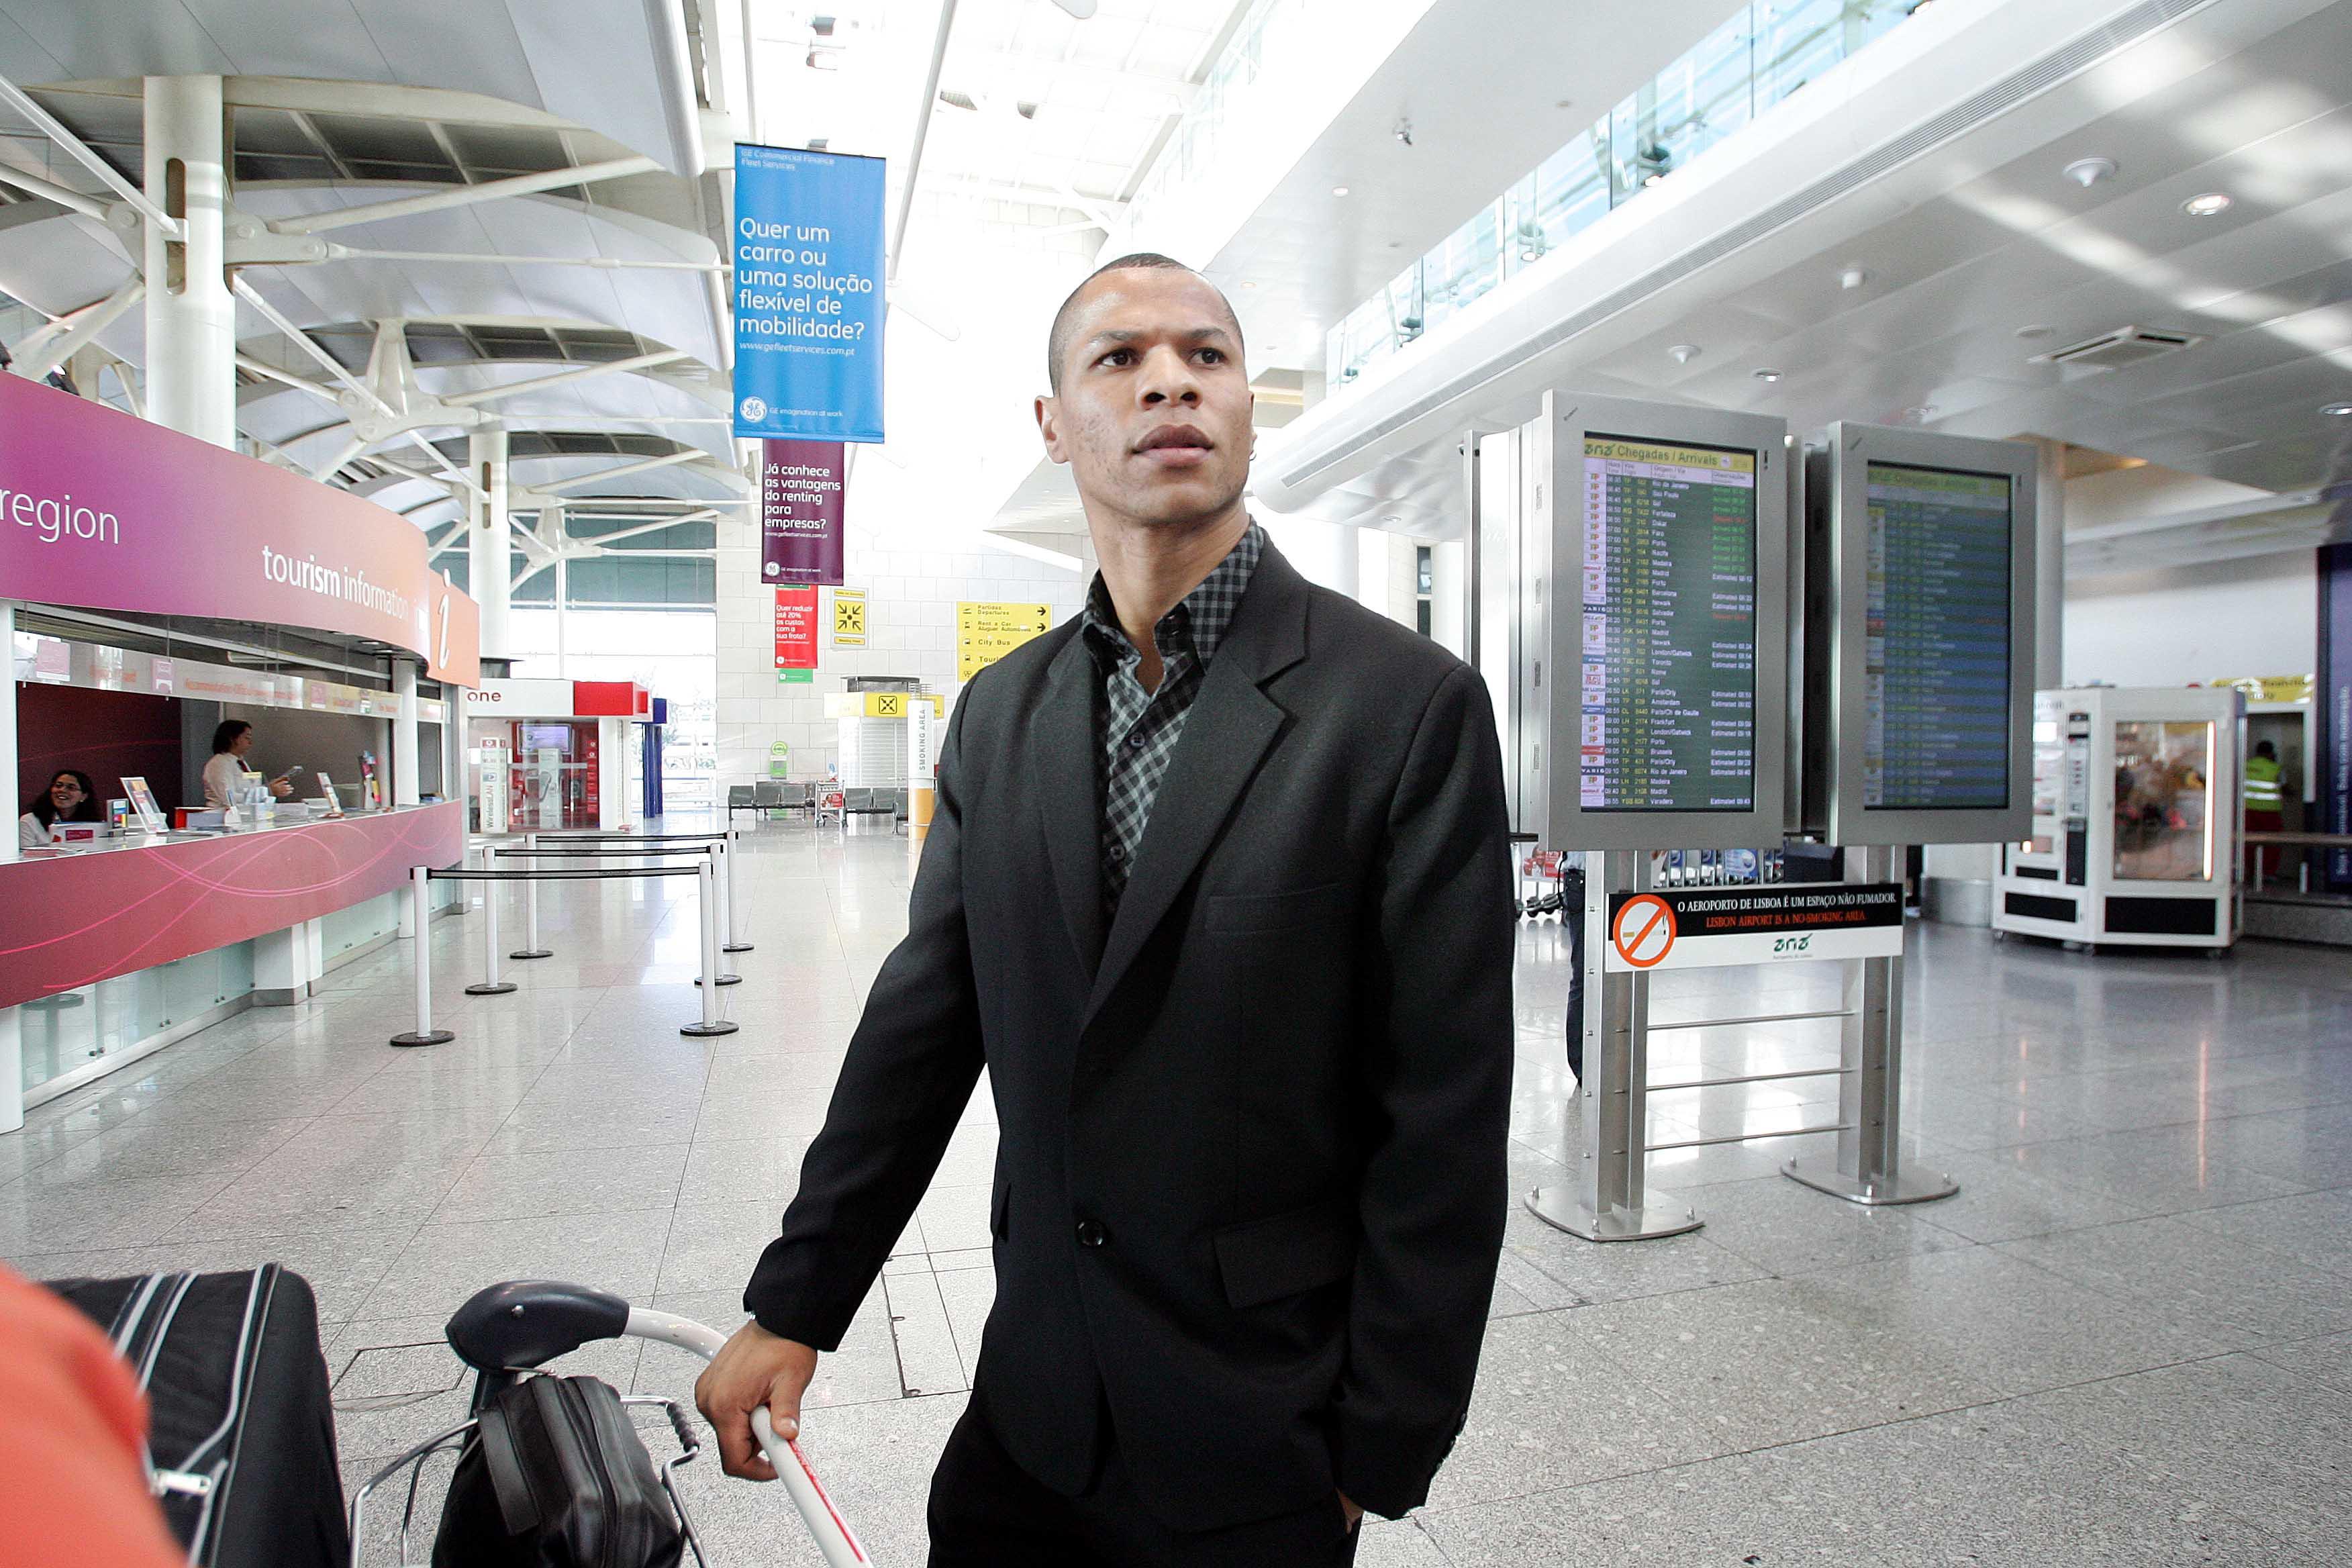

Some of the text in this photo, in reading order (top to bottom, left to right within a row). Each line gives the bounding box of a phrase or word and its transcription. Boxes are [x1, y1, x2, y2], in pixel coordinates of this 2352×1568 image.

[740, 217, 830, 242] Quer um
[740, 245, 826, 266] carro ou
[740, 270, 873, 295] uma solução
[739, 289, 842, 315] flexível de
[740, 315, 865, 340] mobilidade?
[1617, 445, 1669, 461] Chegadas
[1678, 452, 1718, 466] Arrivals
[765, 462, 830, 477] Já conhece
[765, 479, 842, 491] as vantagens
[765, 489, 823, 505] do renting
[0, 489, 119, 544] region
[765, 505, 792, 516] para
[764, 518, 827, 530] empresas?
[261, 545, 409, 622] tourism information
[978, 638, 993, 646] City
[467, 691, 502, 702] one
[1678, 892, 1897, 912] O AEROPORTO DE LISBOA É UM ESPAÇO NÃO FUMADOR
[1706, 916, 1737, 928] LISBON
[1738, 914, 1773, 926] AIRPORT
[1775, 914, 1783, 924] IS
[1784, 914, 1790, 924] A
[1792, 911, 1844, 924] NO-SMOKING
